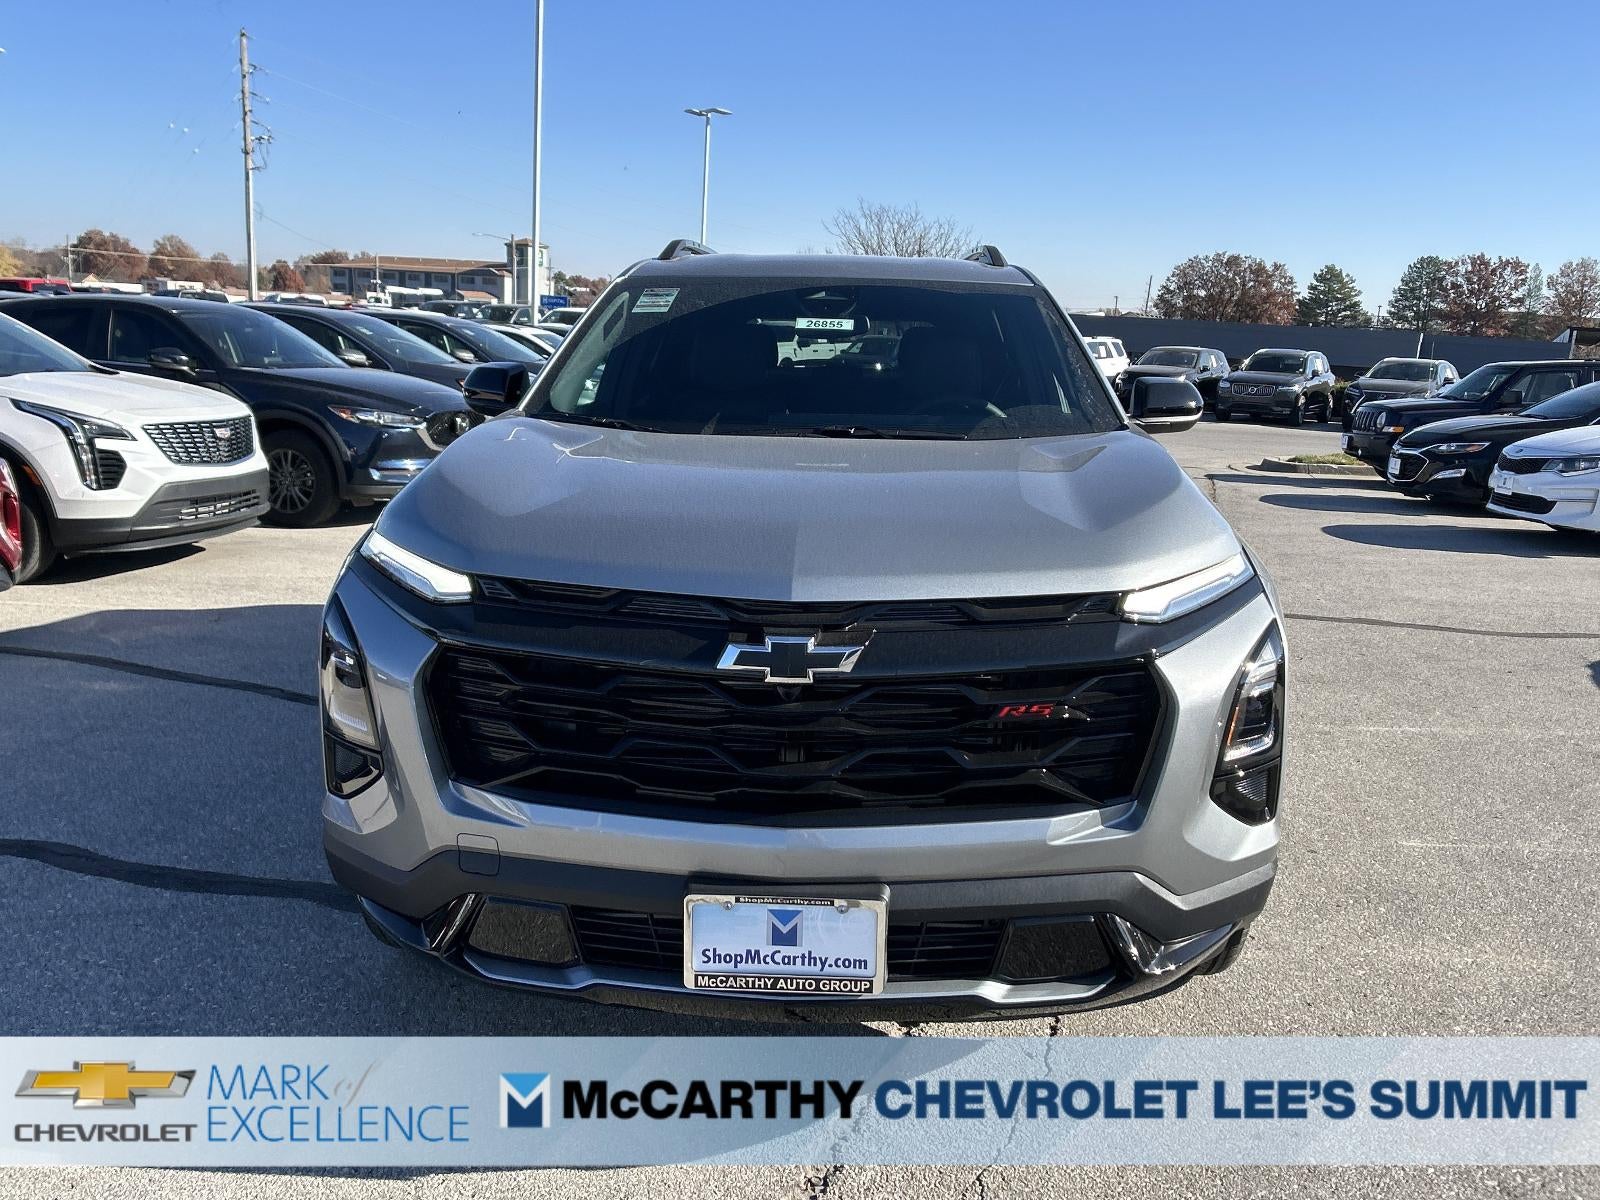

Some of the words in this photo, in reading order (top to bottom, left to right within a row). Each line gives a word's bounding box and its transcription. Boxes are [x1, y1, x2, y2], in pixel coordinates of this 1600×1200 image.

[806, 320, 844, 328] 26855
[998, 703, 1054, 718] RS
[739, 896, 831, 906] ShopMcCarthy.com
[701, 948, 868, 971] ShopMcCarthy.com
[697, 975, 774, 991] McCARTHY
[778, 978, 816, 991] AUTO
[819, 979, 871, 992] GROUP
